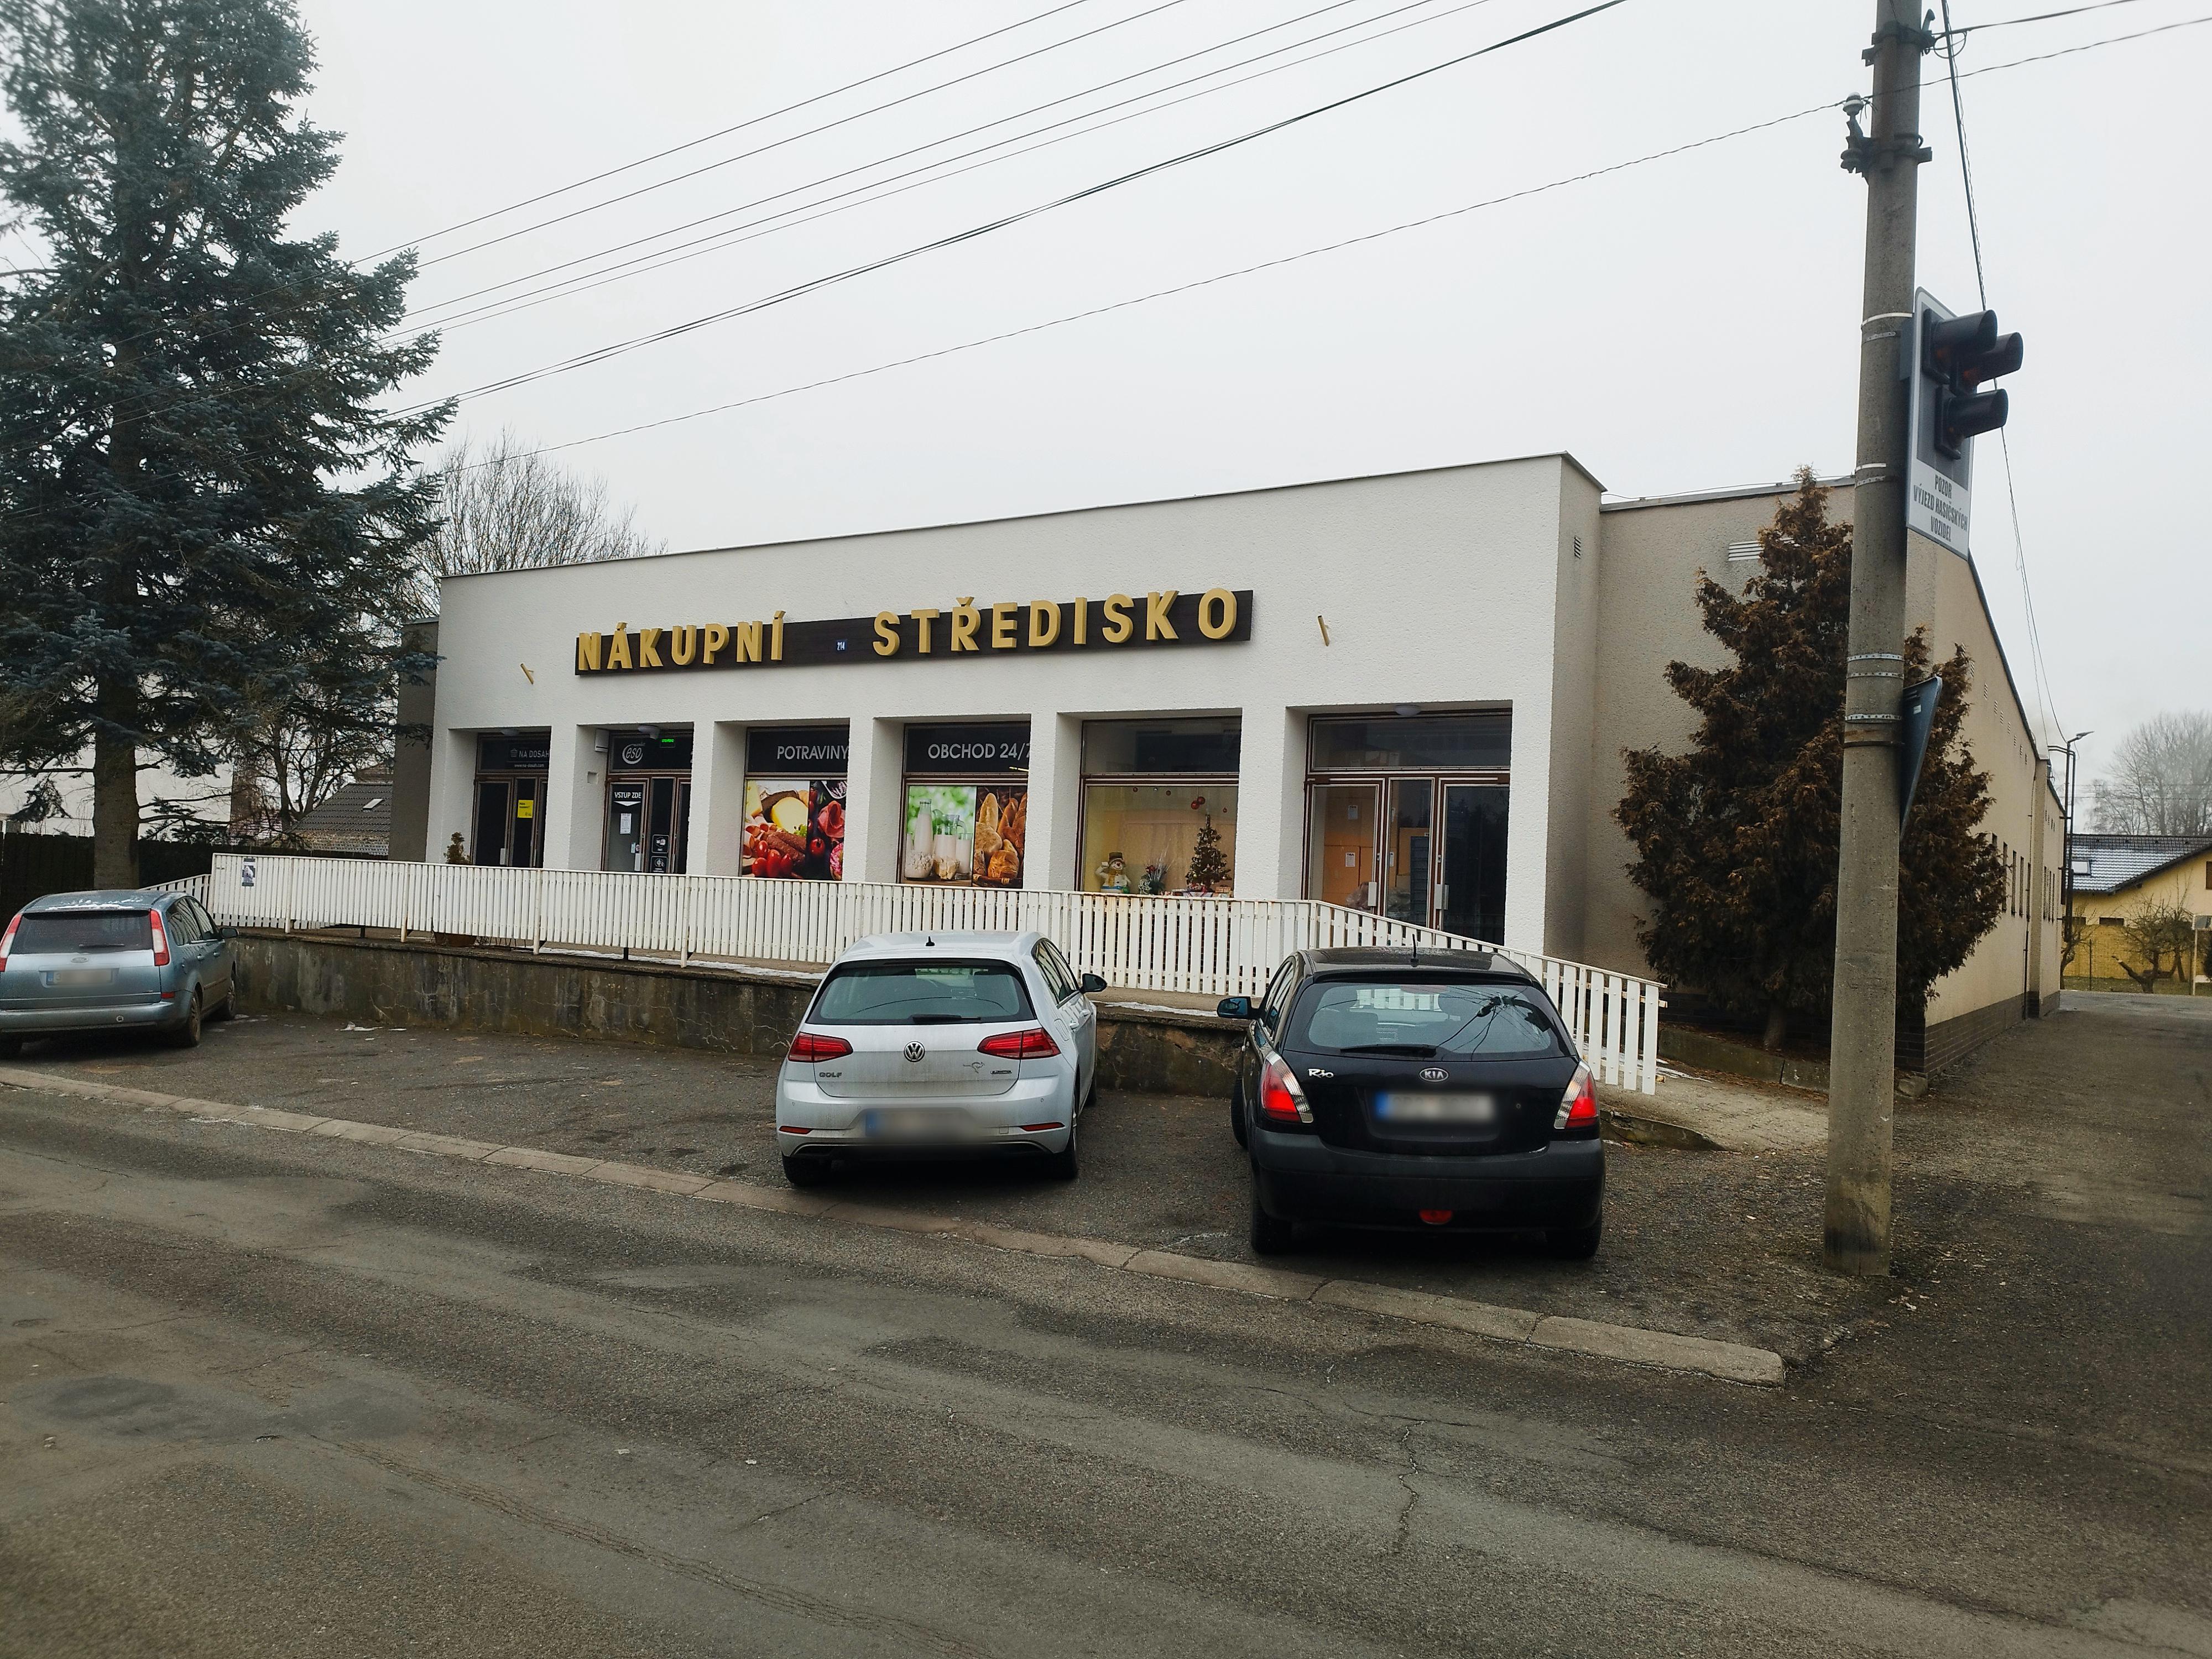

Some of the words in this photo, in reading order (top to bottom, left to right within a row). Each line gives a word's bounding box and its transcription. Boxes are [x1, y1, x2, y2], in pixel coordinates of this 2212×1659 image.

[1934, 474, 1952, 498] POZOR
[1913, 483, 1934, 510] VÝJEZD
[1936, 497, 1968, 531] HASIČSKÝCH
[1931, 515, 1951, 542] VOZIDEL
[578, 610, 786, 671] NÁKUPNÍ
[872, 588, 1238, 656] STŘEDISKO
[837, 641, 846, 651] 214
[626, 748, 642, 759] eso
[776, 745, 849, 760] POTRAVINY
[927, 743, 995, 759] OBCHOD
[1308, 1068, 1334, 1078] Rio
[1424, 1071, 1444, 1079] KIA
